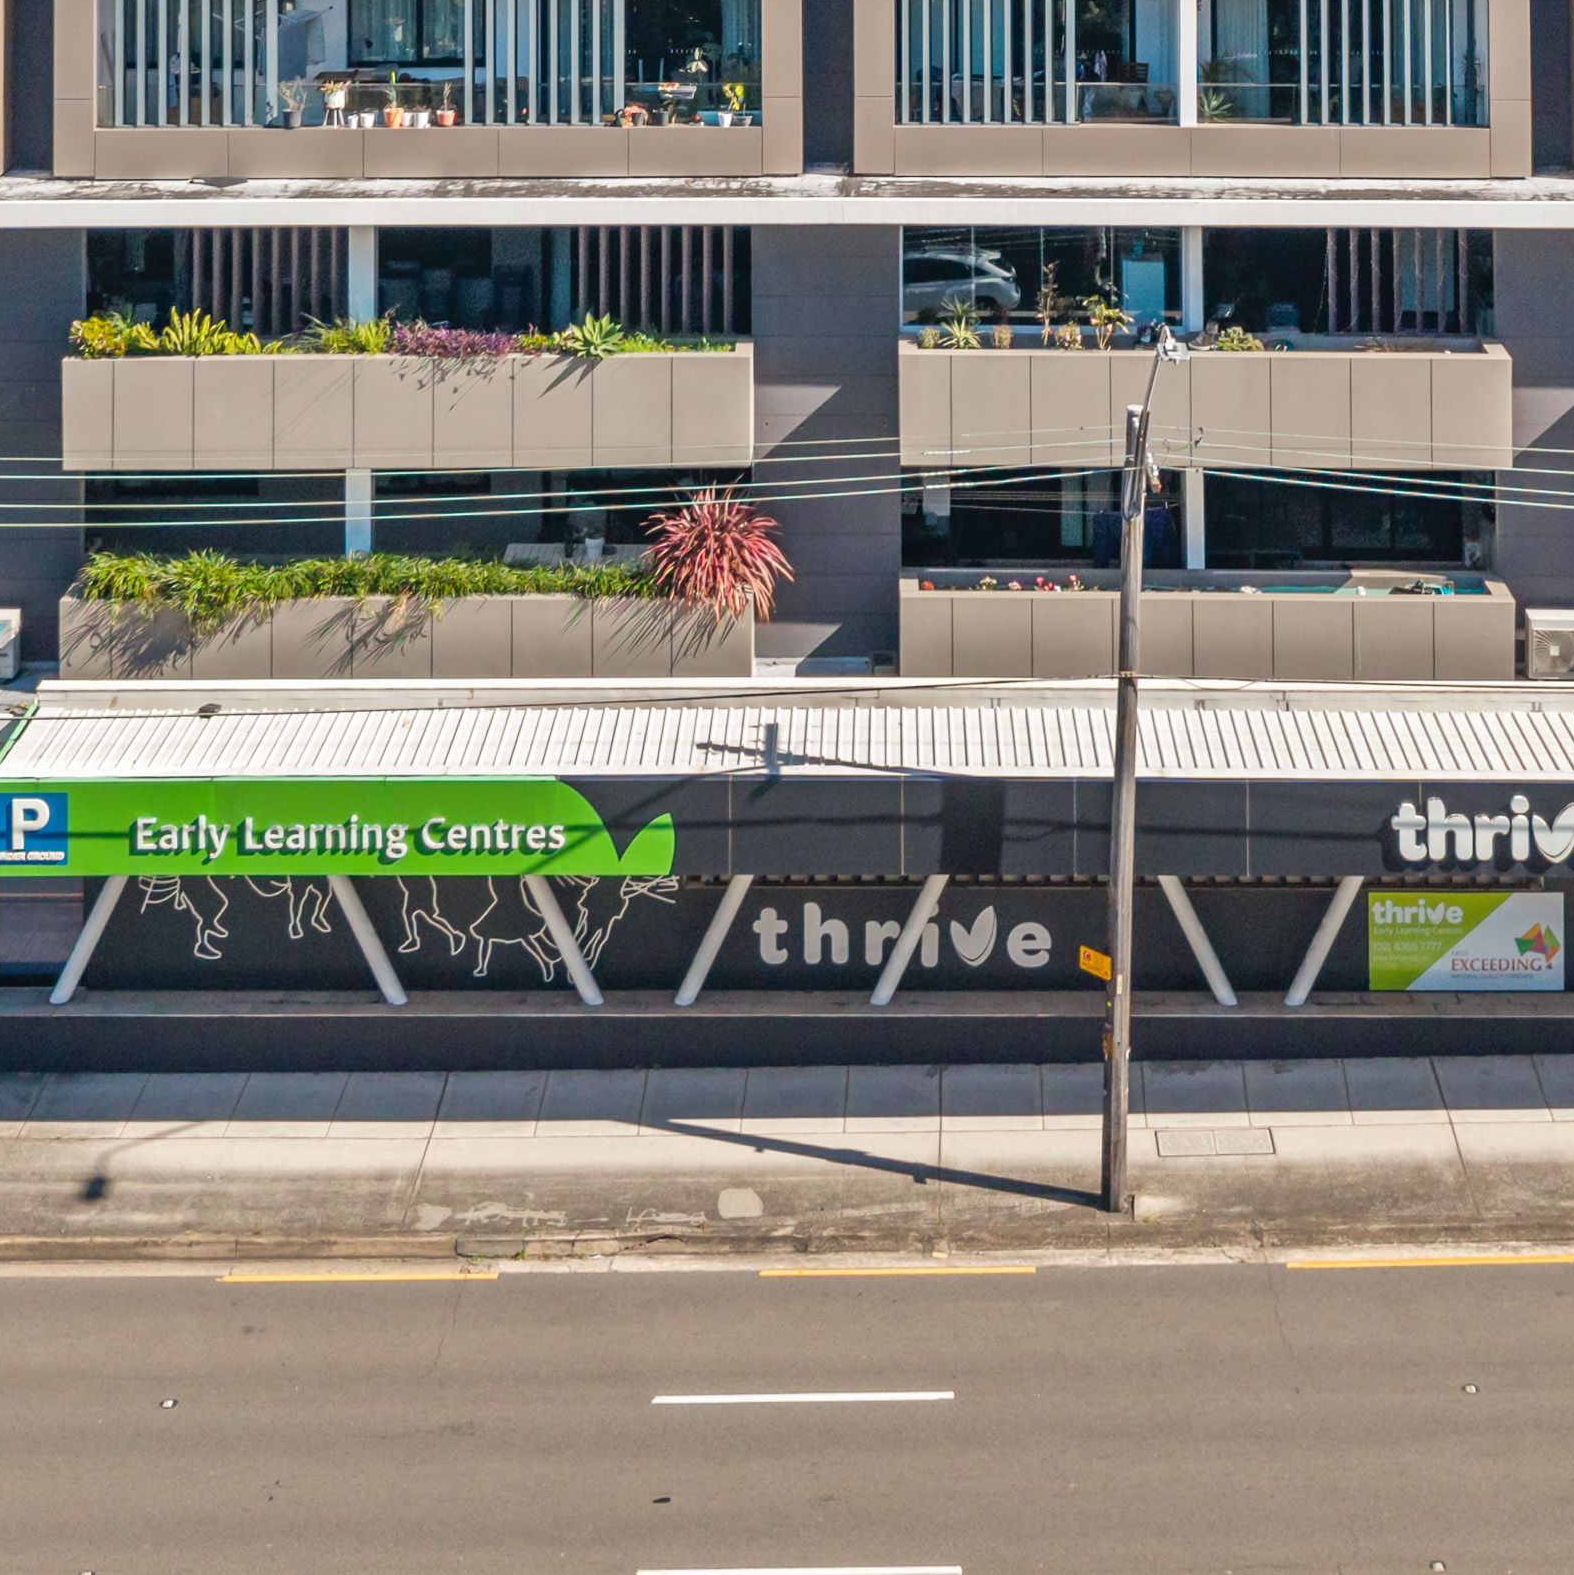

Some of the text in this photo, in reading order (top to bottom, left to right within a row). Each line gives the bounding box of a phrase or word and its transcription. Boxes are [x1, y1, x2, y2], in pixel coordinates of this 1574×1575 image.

[12, 798, 51, 850] P
[135, 814, 566, 860] Early Learning Centres
[752, 902, 1052, 967] thrive
[1371, 898, 1464, 925] thrive
[1451, 958, 1542, 972] EXCEEDING
